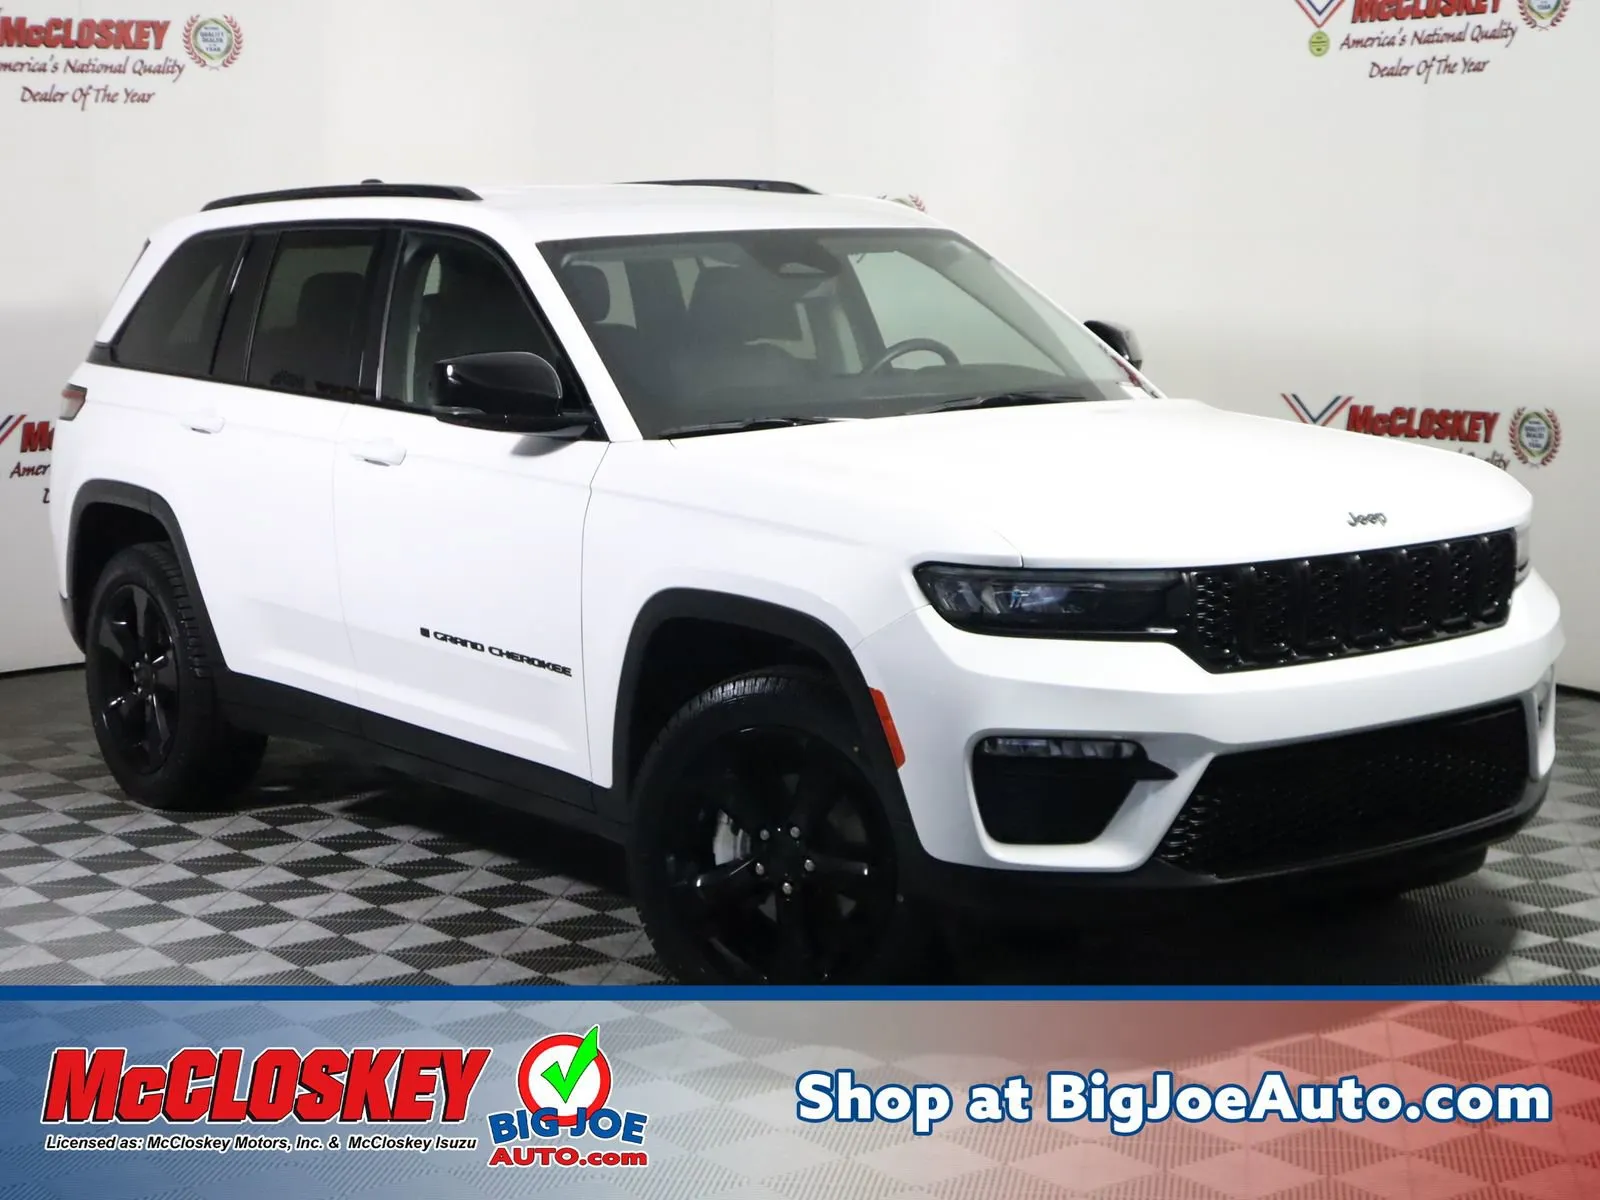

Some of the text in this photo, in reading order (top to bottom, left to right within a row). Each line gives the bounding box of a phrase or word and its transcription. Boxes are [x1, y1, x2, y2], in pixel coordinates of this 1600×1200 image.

[0, 16, 170, 50] McCLOSKEY
[1339, 19, 1518, 51] America's National Quality
[0, 54, 186, 83] merica's National Quality
[1368, 54, 1490, 84] Dealer Of The Year
[20, 84, 156, 112] Dealer Of The Year
[1346, 404, 1501, 443] McCLOSKEY
[1347, 512, 1388, 528] Jeep
[433, 631, 573, 678] GRAND CHEROKEE
